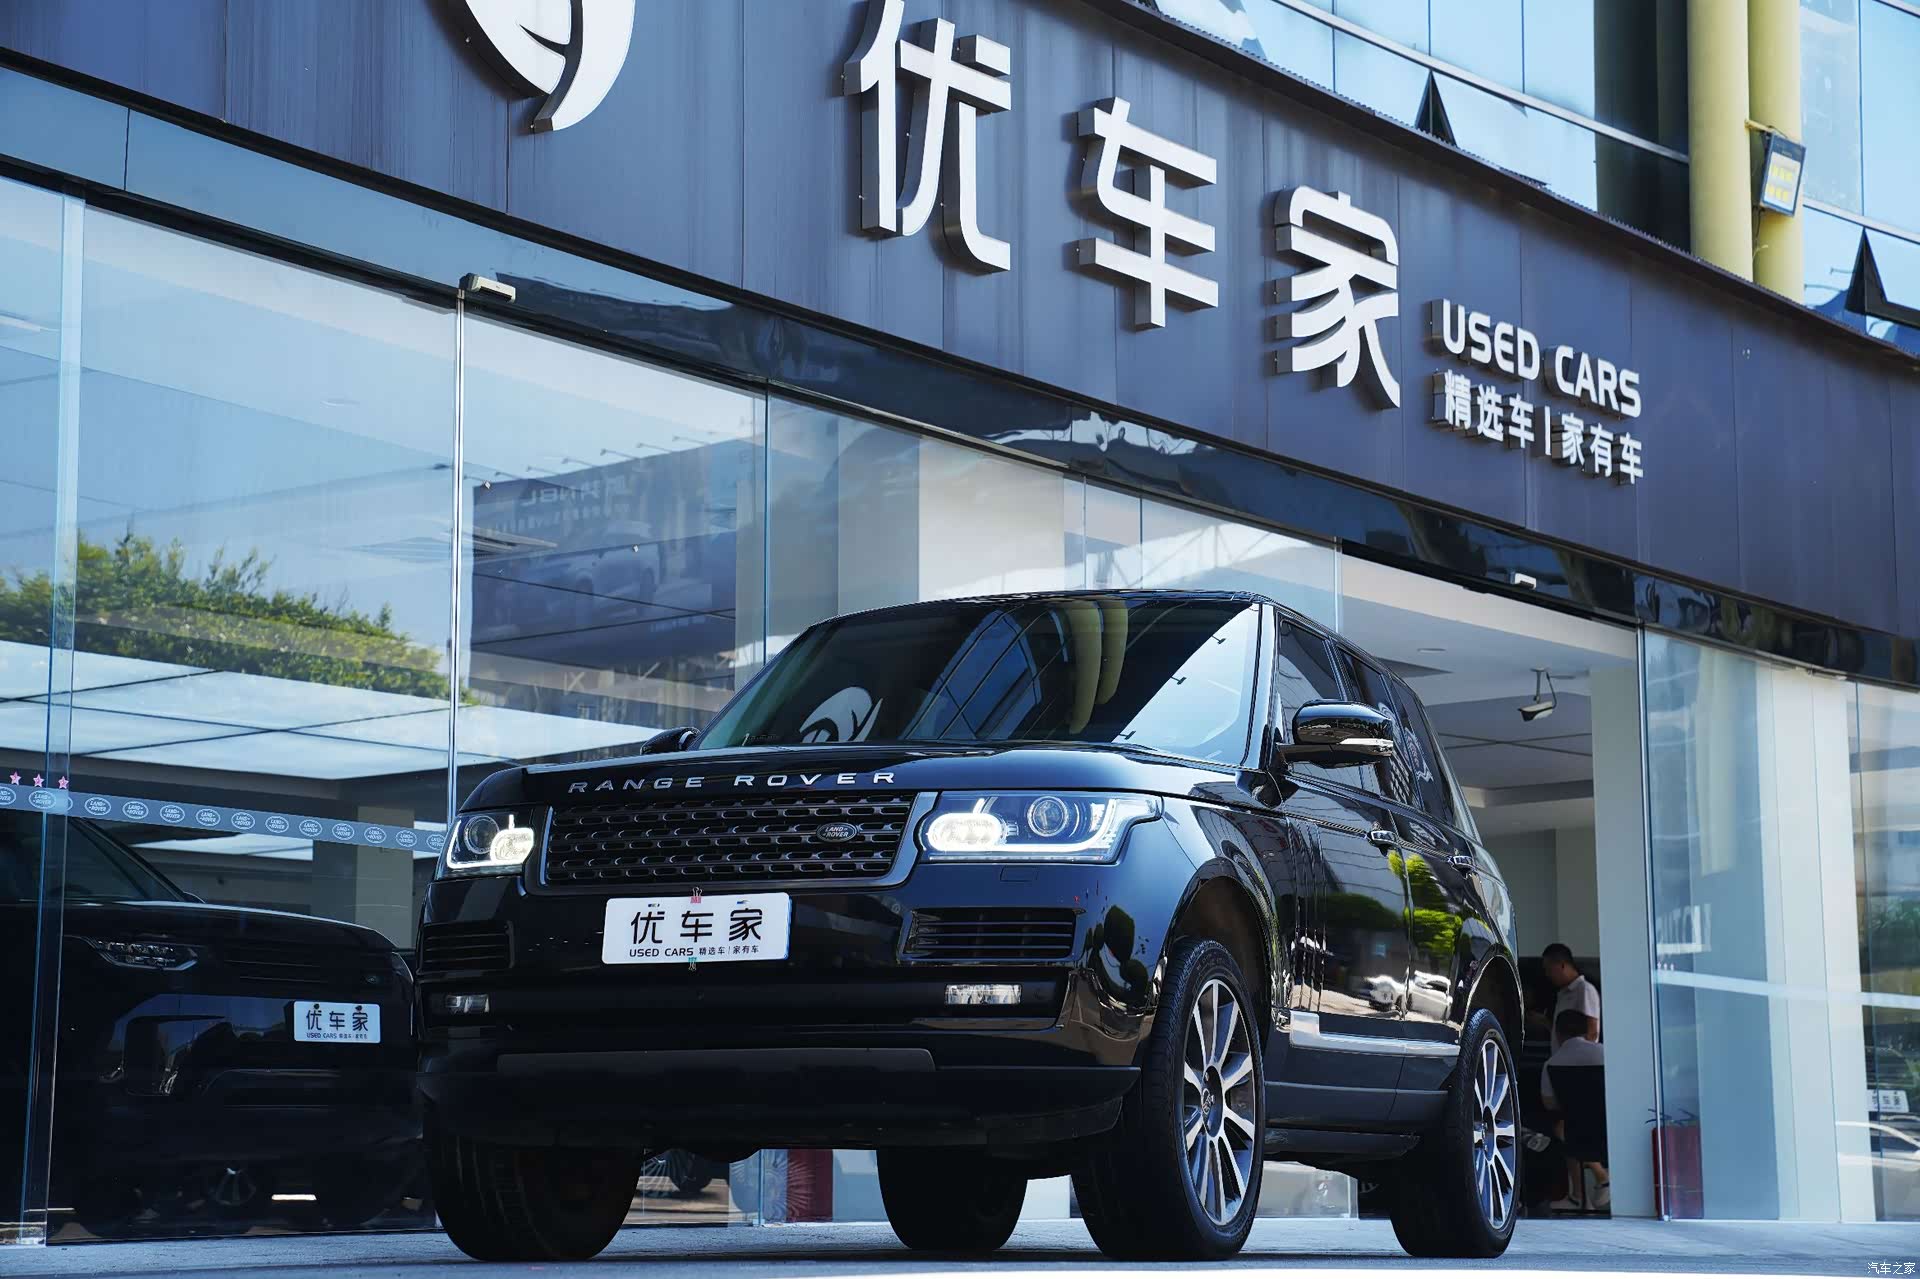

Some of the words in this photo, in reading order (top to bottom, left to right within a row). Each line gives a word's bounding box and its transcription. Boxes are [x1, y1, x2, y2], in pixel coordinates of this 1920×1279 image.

[858, 0, 1400, 408] 优车家
[1442, 298, 1541, 381] USED
[1554, 345, 1642, 418] CARS
[567, 777, 705, 794] RANGE
[733, 772, 895, 787] ROVER
[630, 907, 763, 945] 优车家
[629, 948, 660, 958] USED
[664, 947, 694, 957] CARS
[306, 1010, 368, 1031] 优车家
